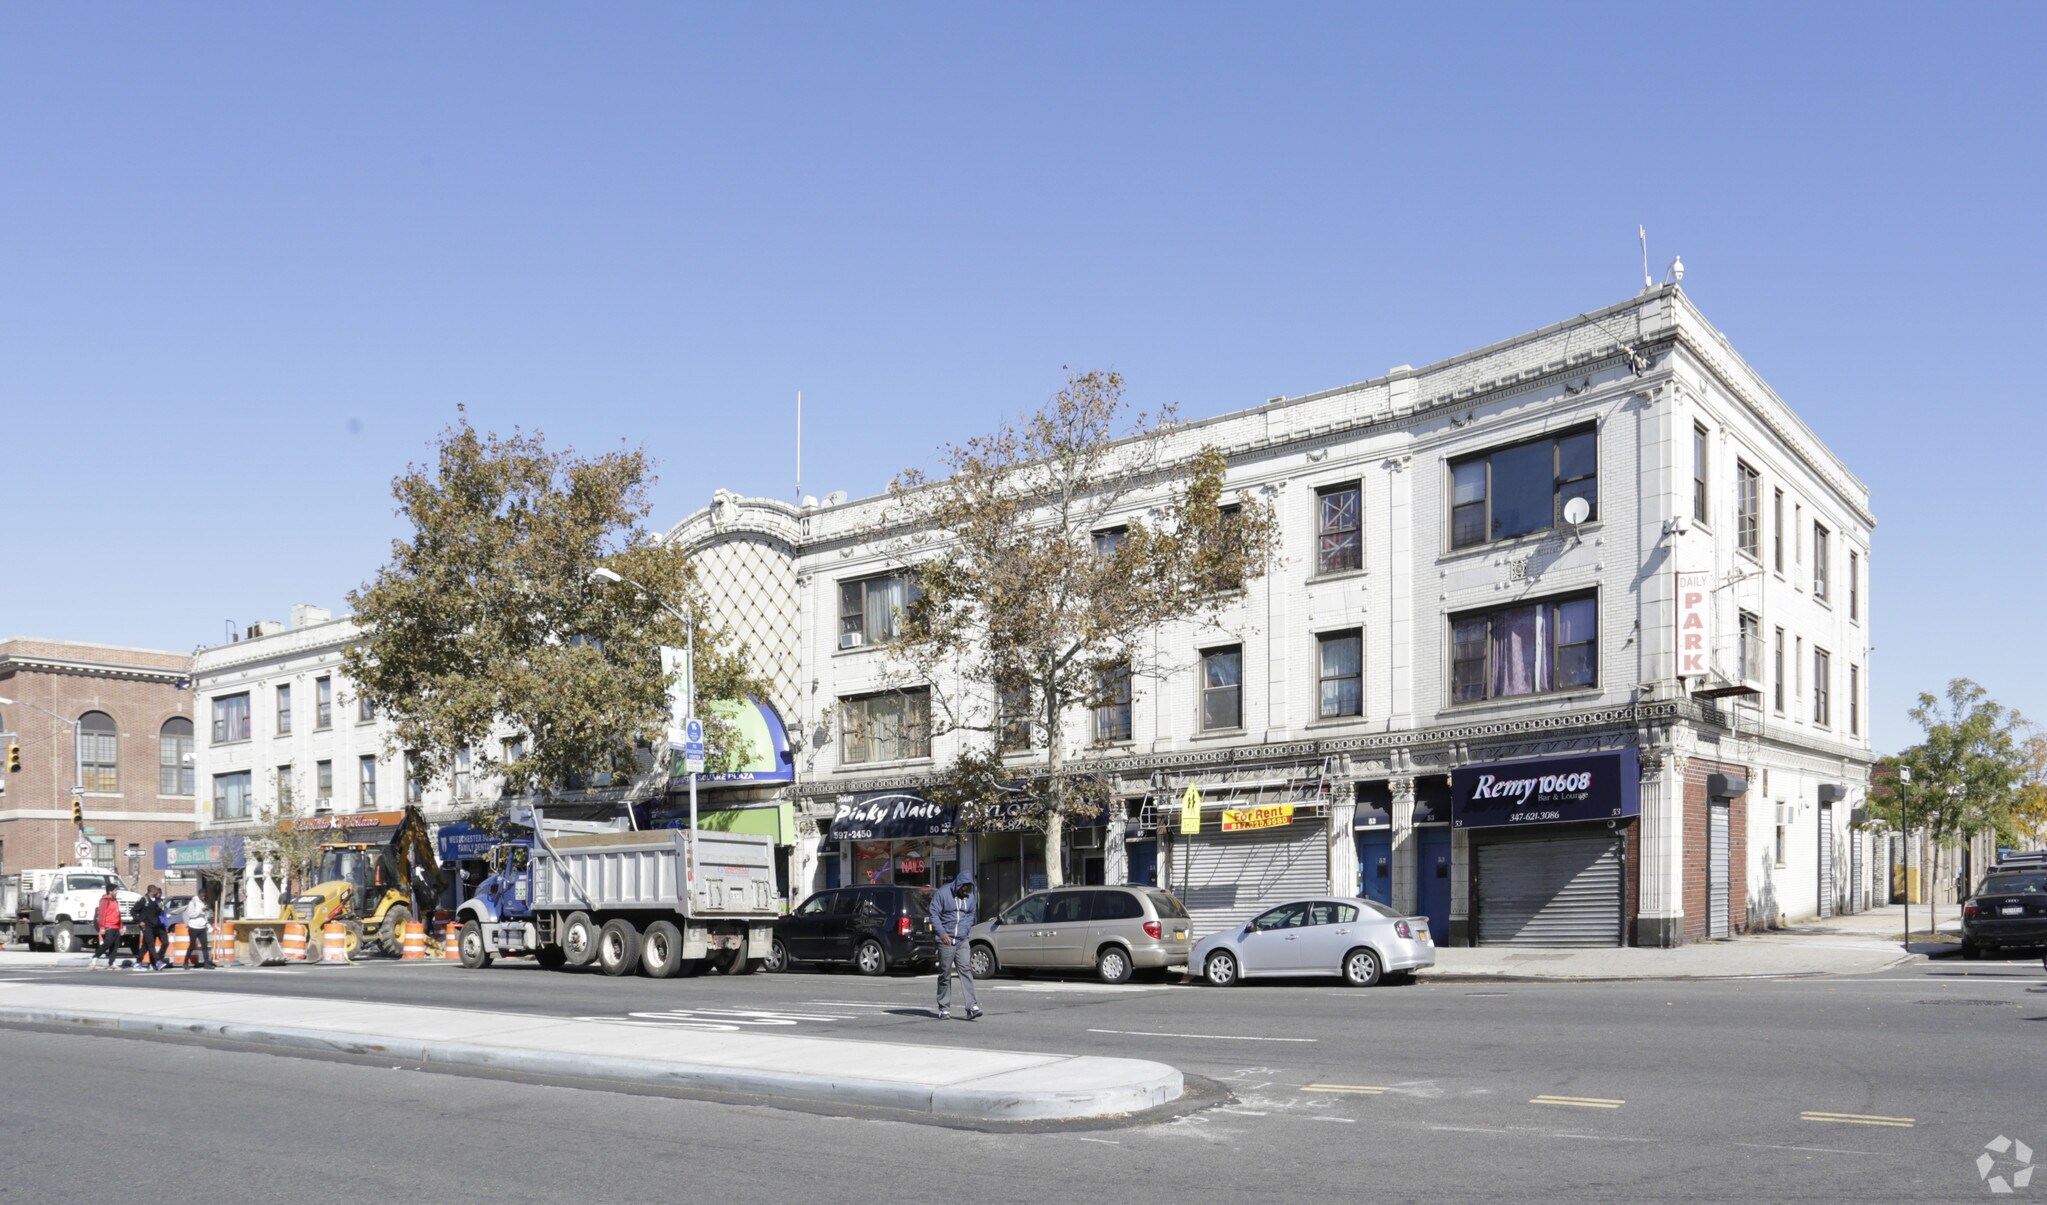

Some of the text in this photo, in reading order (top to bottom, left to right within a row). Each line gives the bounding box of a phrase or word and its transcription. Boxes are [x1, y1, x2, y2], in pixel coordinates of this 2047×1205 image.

[1680, 576, 1707, 588] DAILY
[1682, 592, 1704, 671] PARK
[1472, 772, 1592, 805] Remy 10608
[1561, 792, 1589, 800] Lounge
[835, 804, 888, 824] Pinky
[892, 801, 941, 819] Nails
[1234, 807, 1283, 822] For Rent
[1509, 811, 1560, 822] 347-621-3086
[1611, 808, 1621, 816] 53
[833, 830, 872, 840] 597-2450
[901, 860, 925, 873] NAILS
